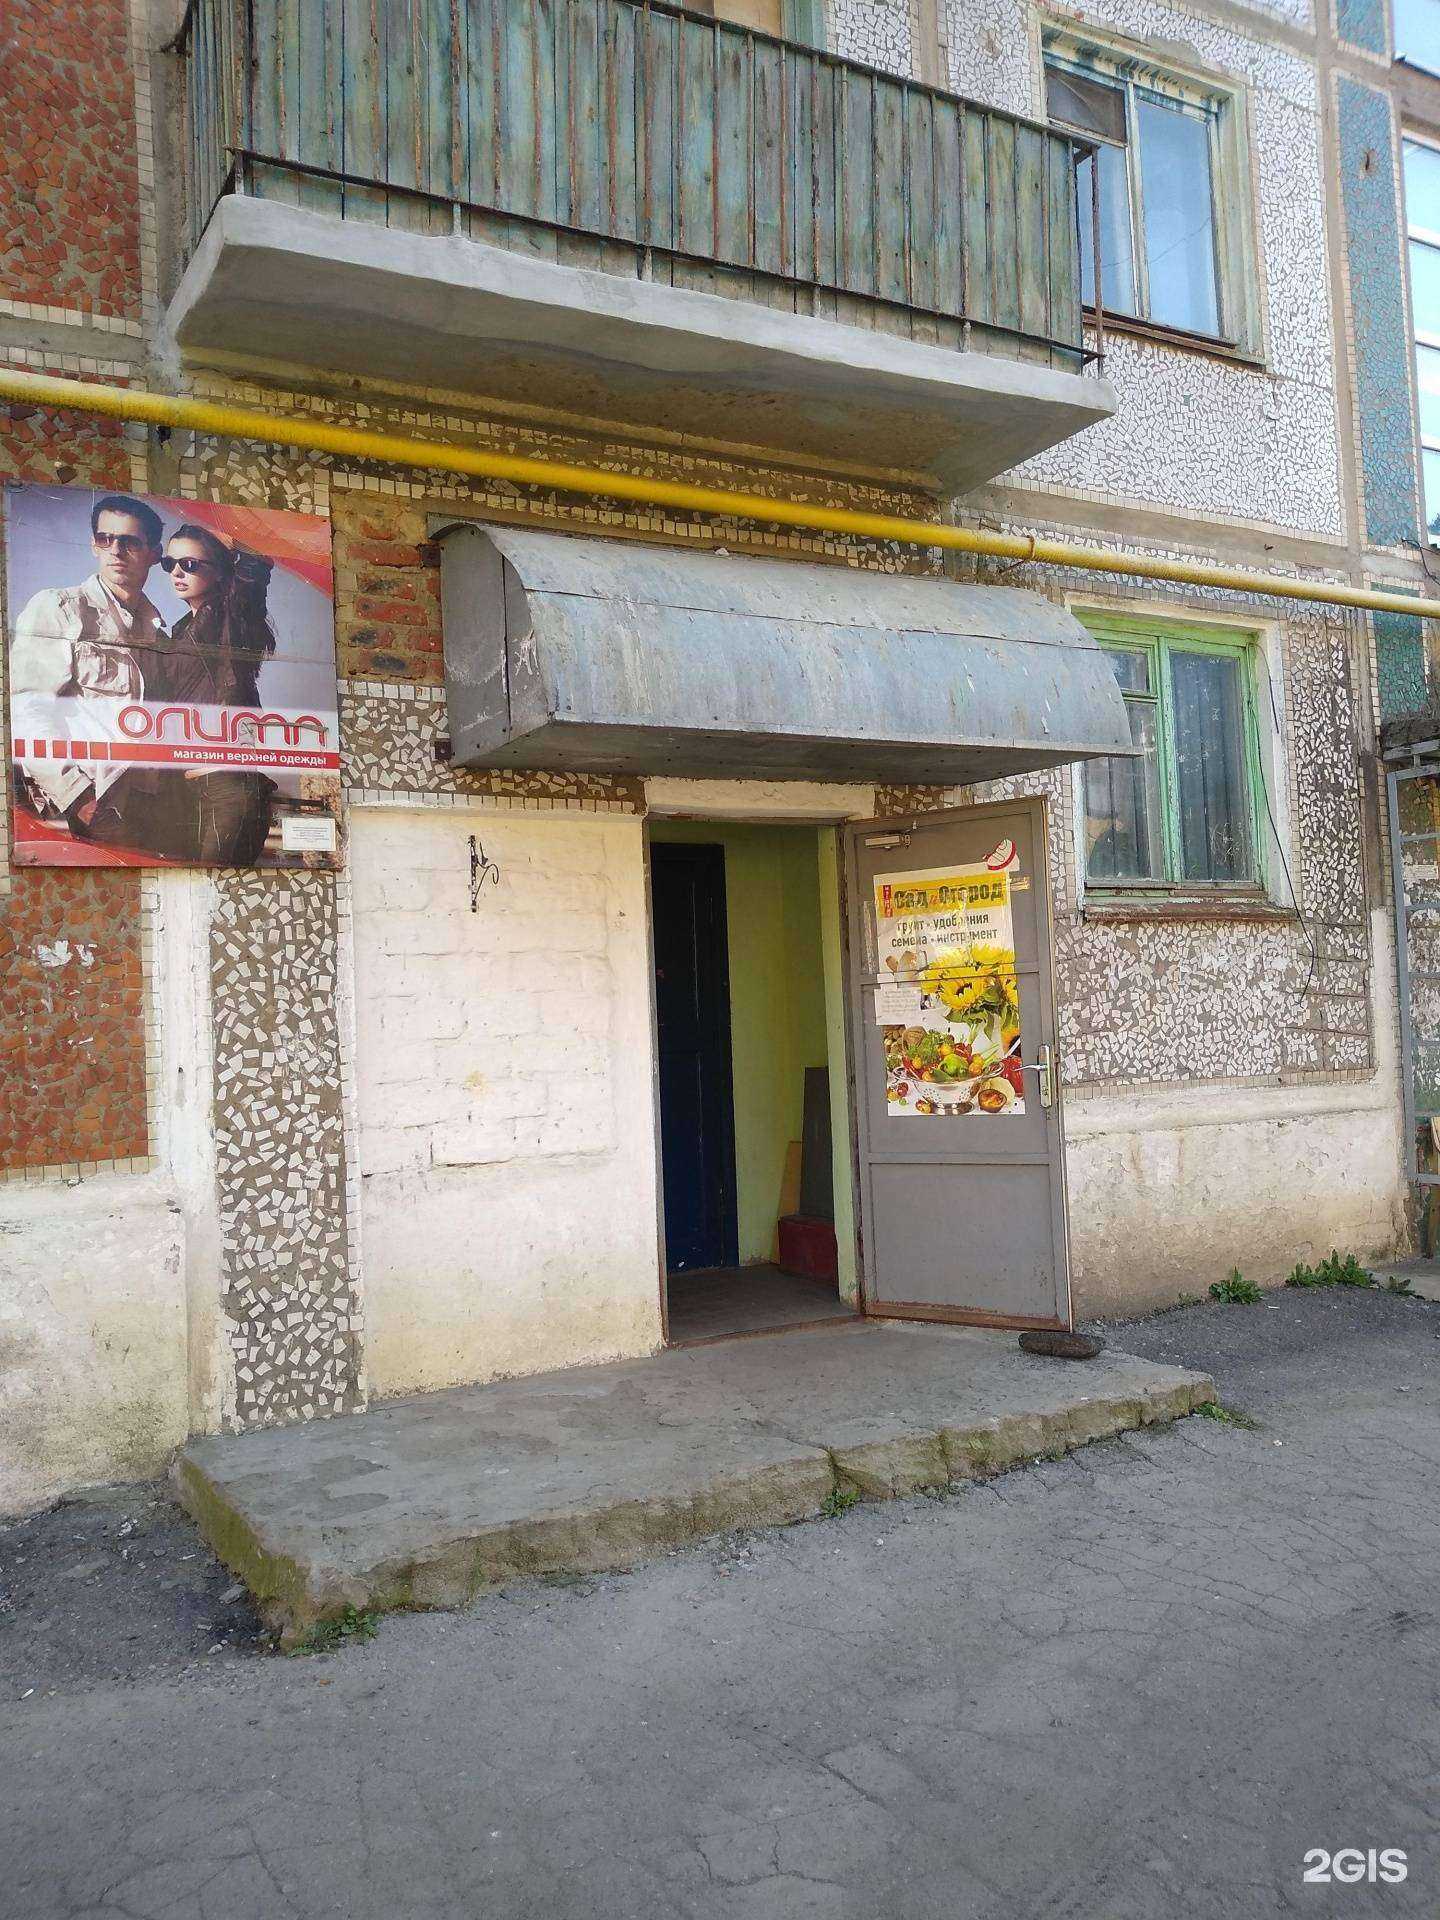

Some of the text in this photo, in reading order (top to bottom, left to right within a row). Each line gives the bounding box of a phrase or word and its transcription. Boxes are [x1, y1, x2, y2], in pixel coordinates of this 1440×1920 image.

[173, 749, 327, 766] магазин верхней одежды
[938, 882, 1004, 905] Огород
[897, 913, 989, 935] грунт удобния
[891, 933, 928, 948] семена
